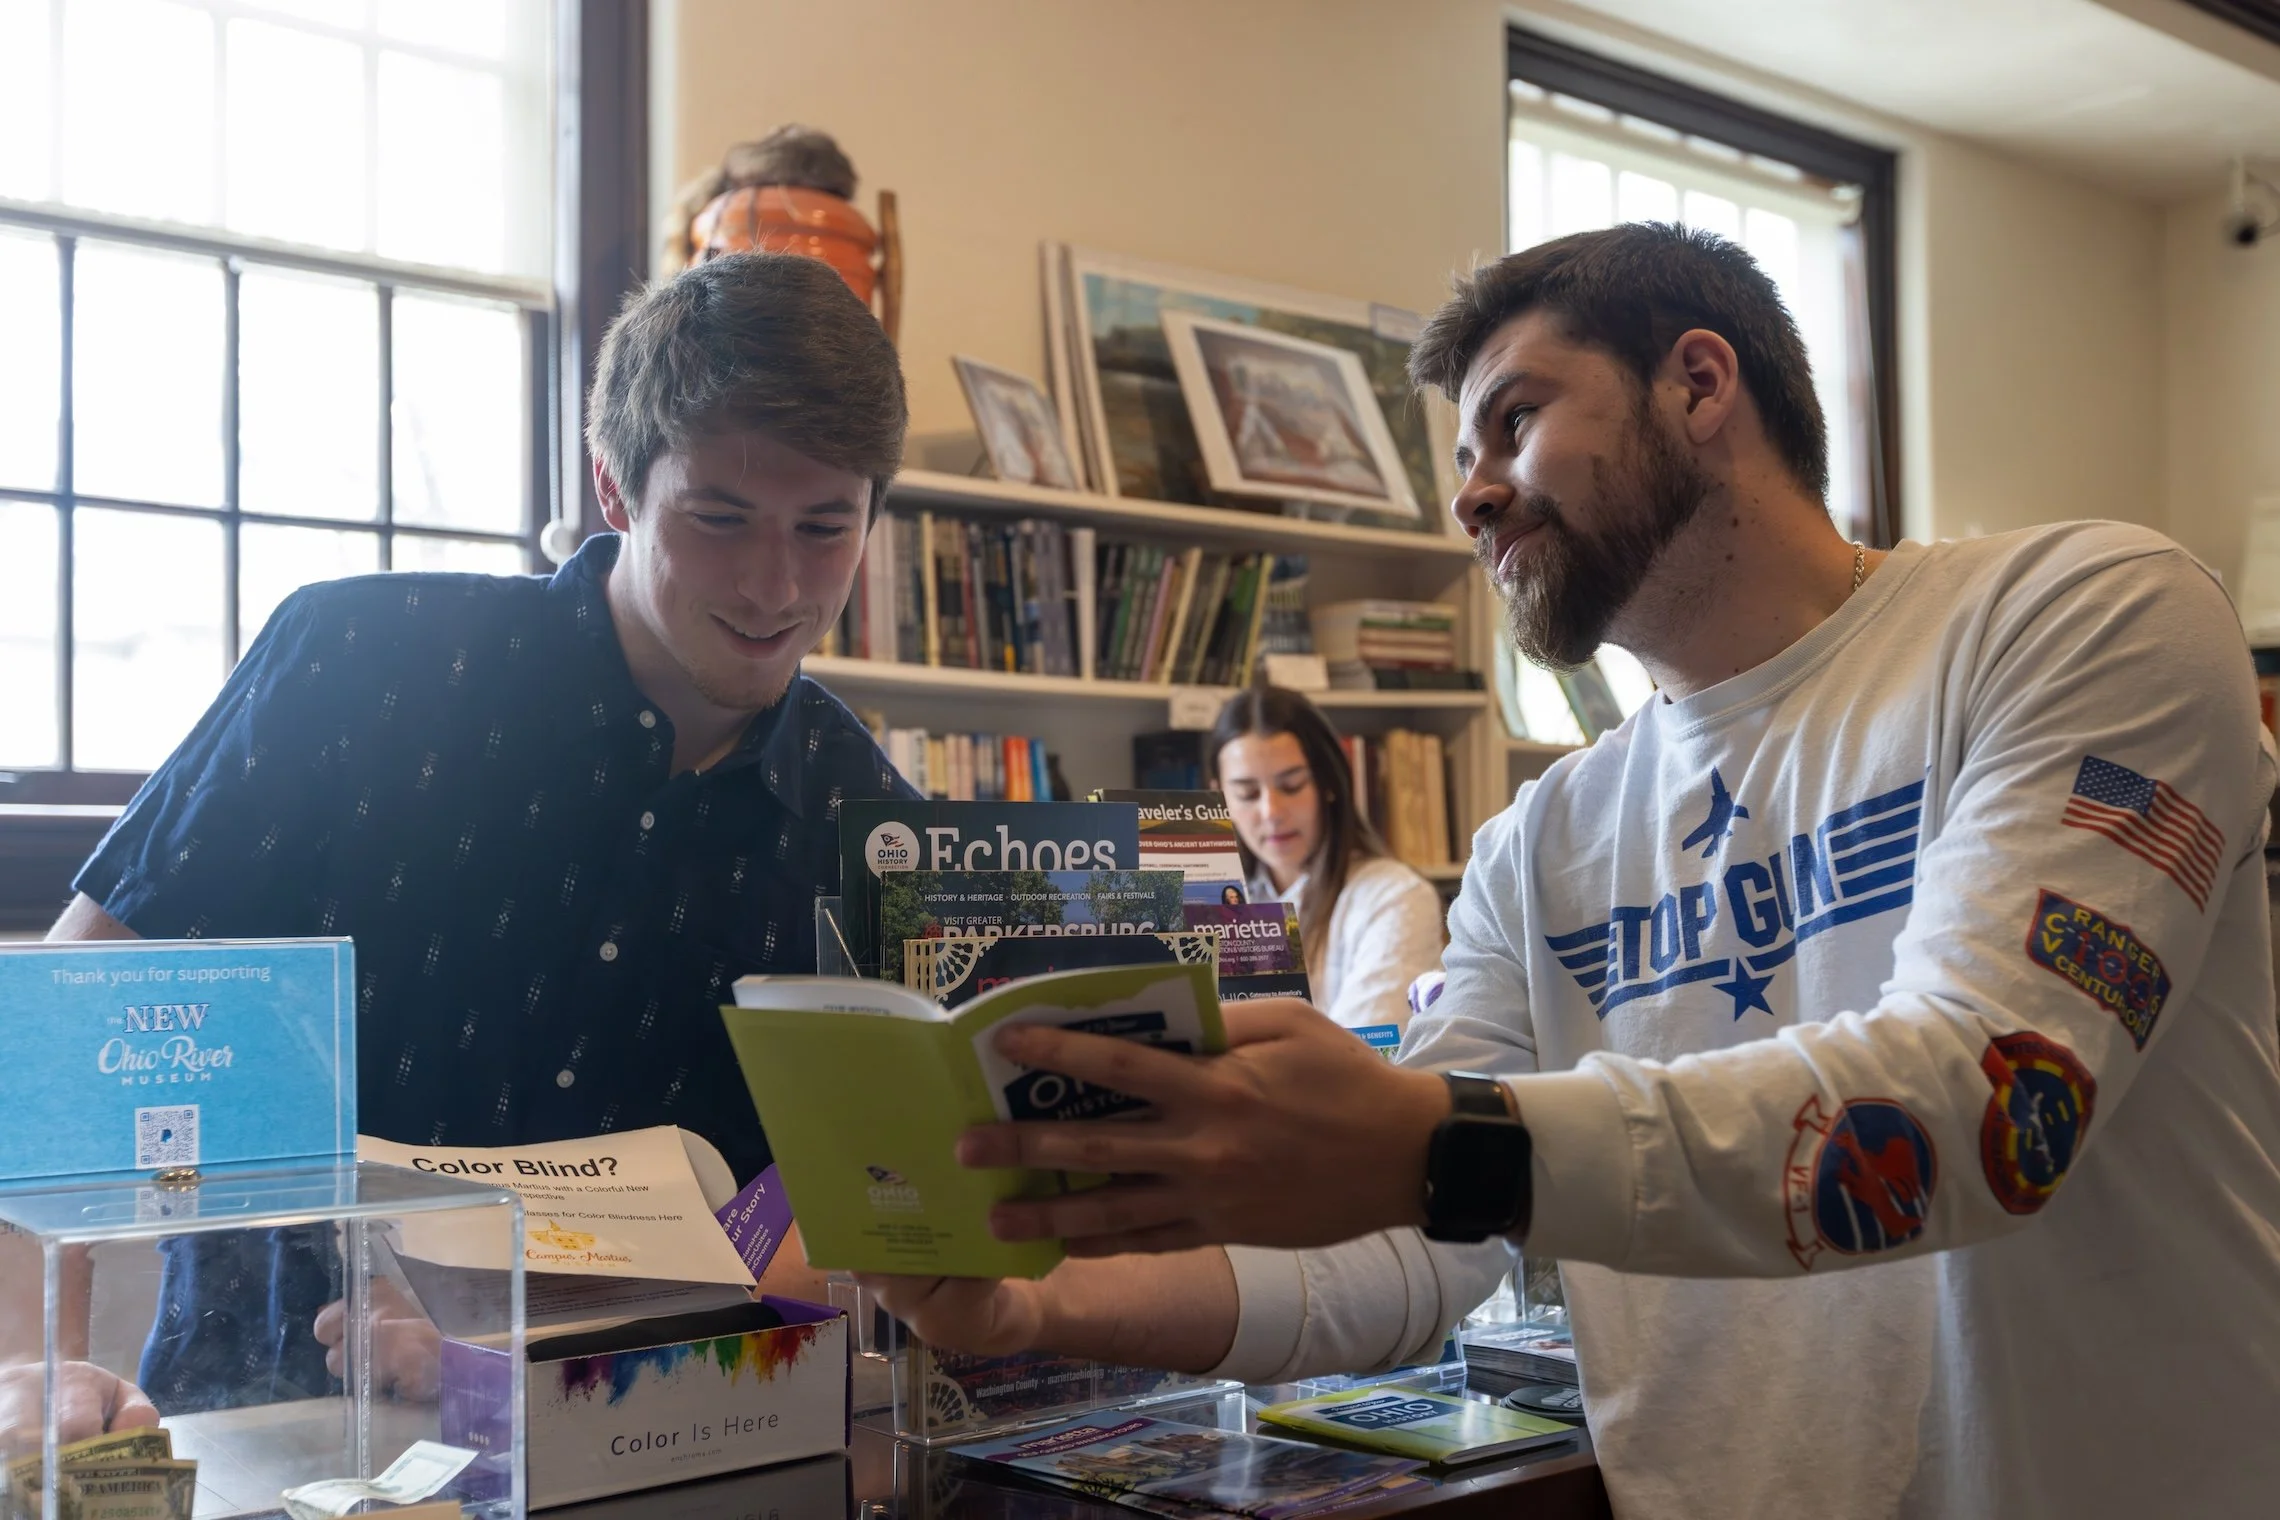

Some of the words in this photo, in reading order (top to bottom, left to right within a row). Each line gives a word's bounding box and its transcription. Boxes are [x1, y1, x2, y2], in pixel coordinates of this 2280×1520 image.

[1138, 804, 1193, 820] aveler's
[877, 849, 908, 858] OHIO
[925, 825, 1117, 871] Echoes
[924, 894, 957, 902] HISTORY
[958, 894, 965, 902] &
[1049, 893, 1091, 901] RECREATION
[1097, 892, 1116, 900] FAIRS
[1117, 892, 1122, 900] &
[1123, 891, 1155, 900] FESTIVALS
[1611, 881, 1717, 981] TOP
[1723, 828, 1837, 948] GUN
[944, 917, 965, 925] VISIT
[966, 916, 1002, 925] GREATER
[1193, 919, 1282, 939] marietta
[2073, 908, 2160, 982] RANGER
[51, 968, 105, 985] Thank
[110, 970, 144, 987] you
[147, 966, 174, 982] for
[177, 965, 271, 983] supporting
[124, 1003, 209, 1033] NEW
[1367, 1031, 1394, 1039] BENEFITS
[98, 1037, 157, 1074] Ohio
[160, 1034, 234, 1073] River
[122, 1074, 213, 1085] MUSEUM
[412, 1157, 503, 1175] Color
[512, 1157, 618, 1178] Blind?
[512, 1182, 550, 1192] Martius
[585, 1185, 625, 1193] Colorful
[519, 1192, 565, 1201] rspective
[740, 1183, 766, 1224] Story
[608, 1213, 657, 1221] Blindness
[722, 1208, 738, 1232] are
[742, 1223, 764, 1261] olorIsHere
[746, 1228, 769, 1267] olorUnites
[751, 1237, 772, 1272] nChroma
[976, 1382, 1014, 1399] Washington
[1015, 1378, 1039, 1393] County
[1349, 1402, 1433, 1422] OHIO
[1381, 1410, 1440, 1424] HISTORY
[611, 1431, 680, 1456] Color
[693, 1423, 712, 1442] Is
[724, 1414, 779, 1436] Here
